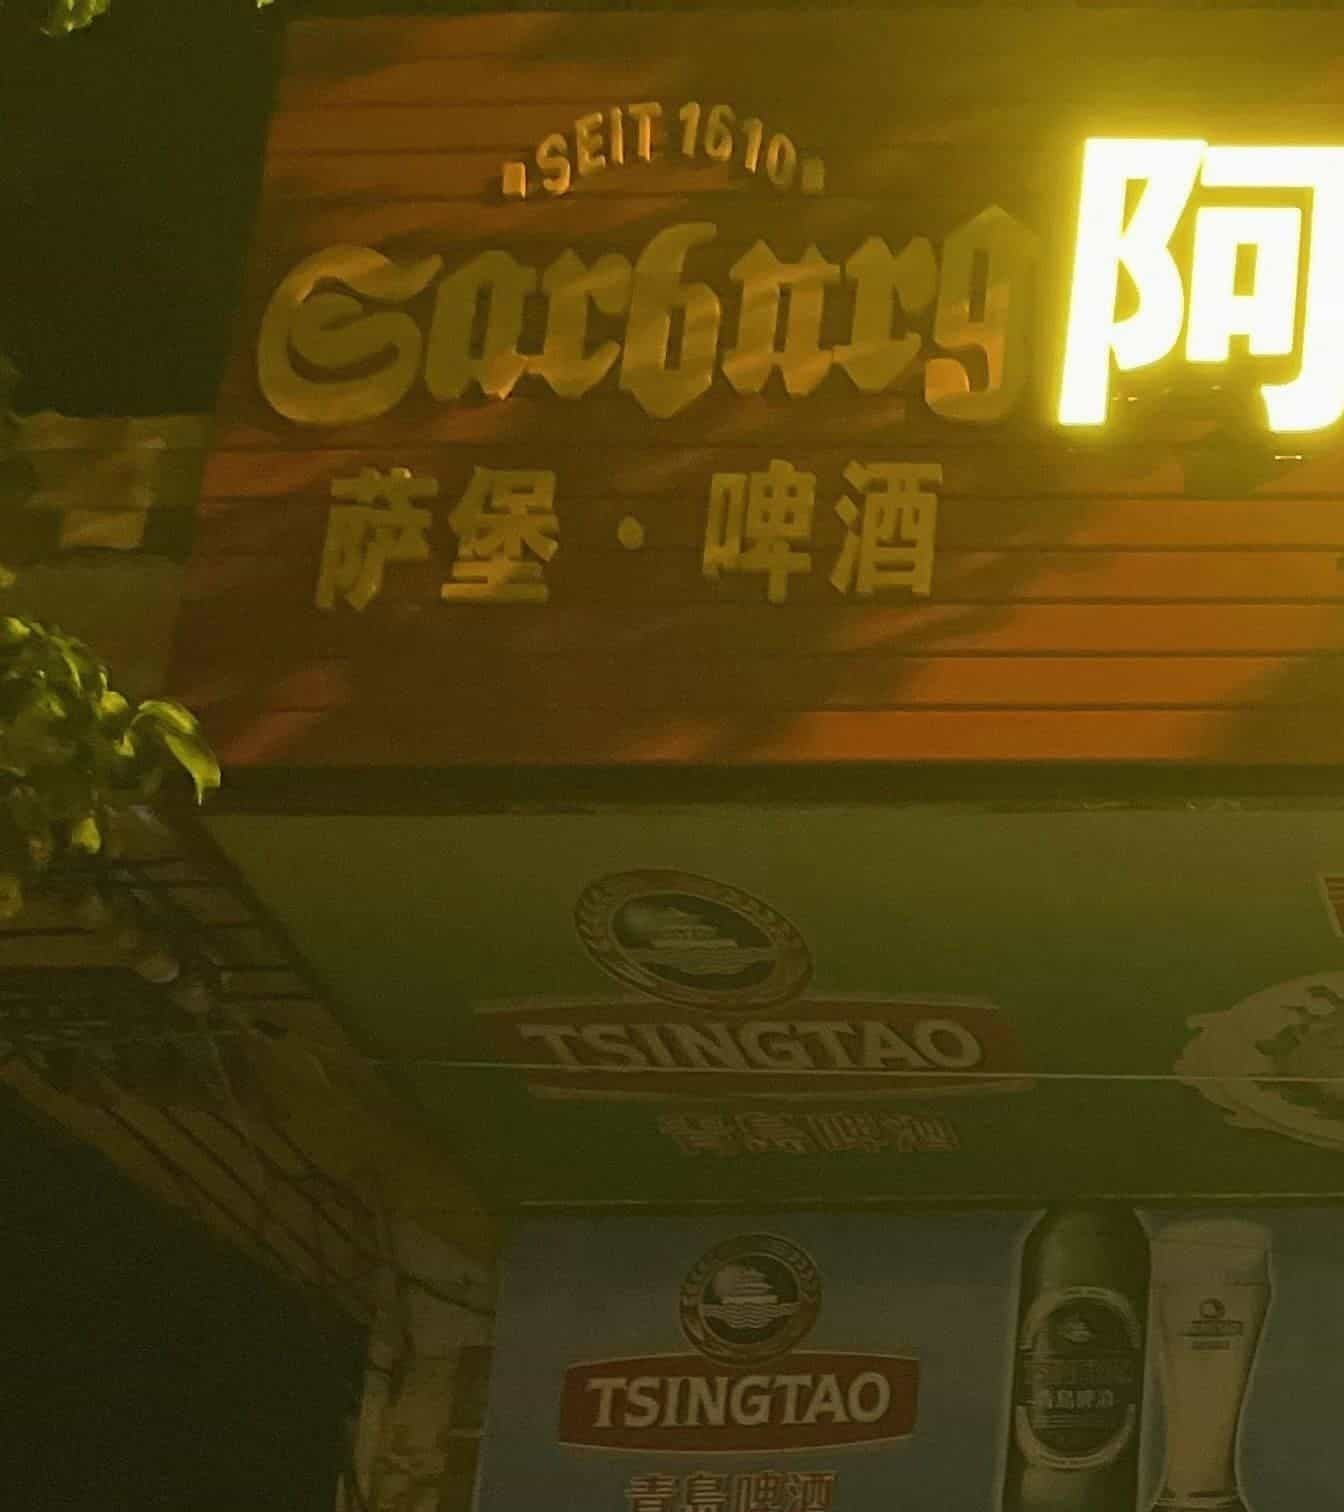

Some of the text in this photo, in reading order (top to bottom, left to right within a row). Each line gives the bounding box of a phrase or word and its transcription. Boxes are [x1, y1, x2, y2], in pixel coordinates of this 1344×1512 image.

[533, 99, 800, 197] SEIT 1610
[517, 1018, 986, 1074] TSINGTAO
[582, 1371, 893, 1430] TSINGTAO
